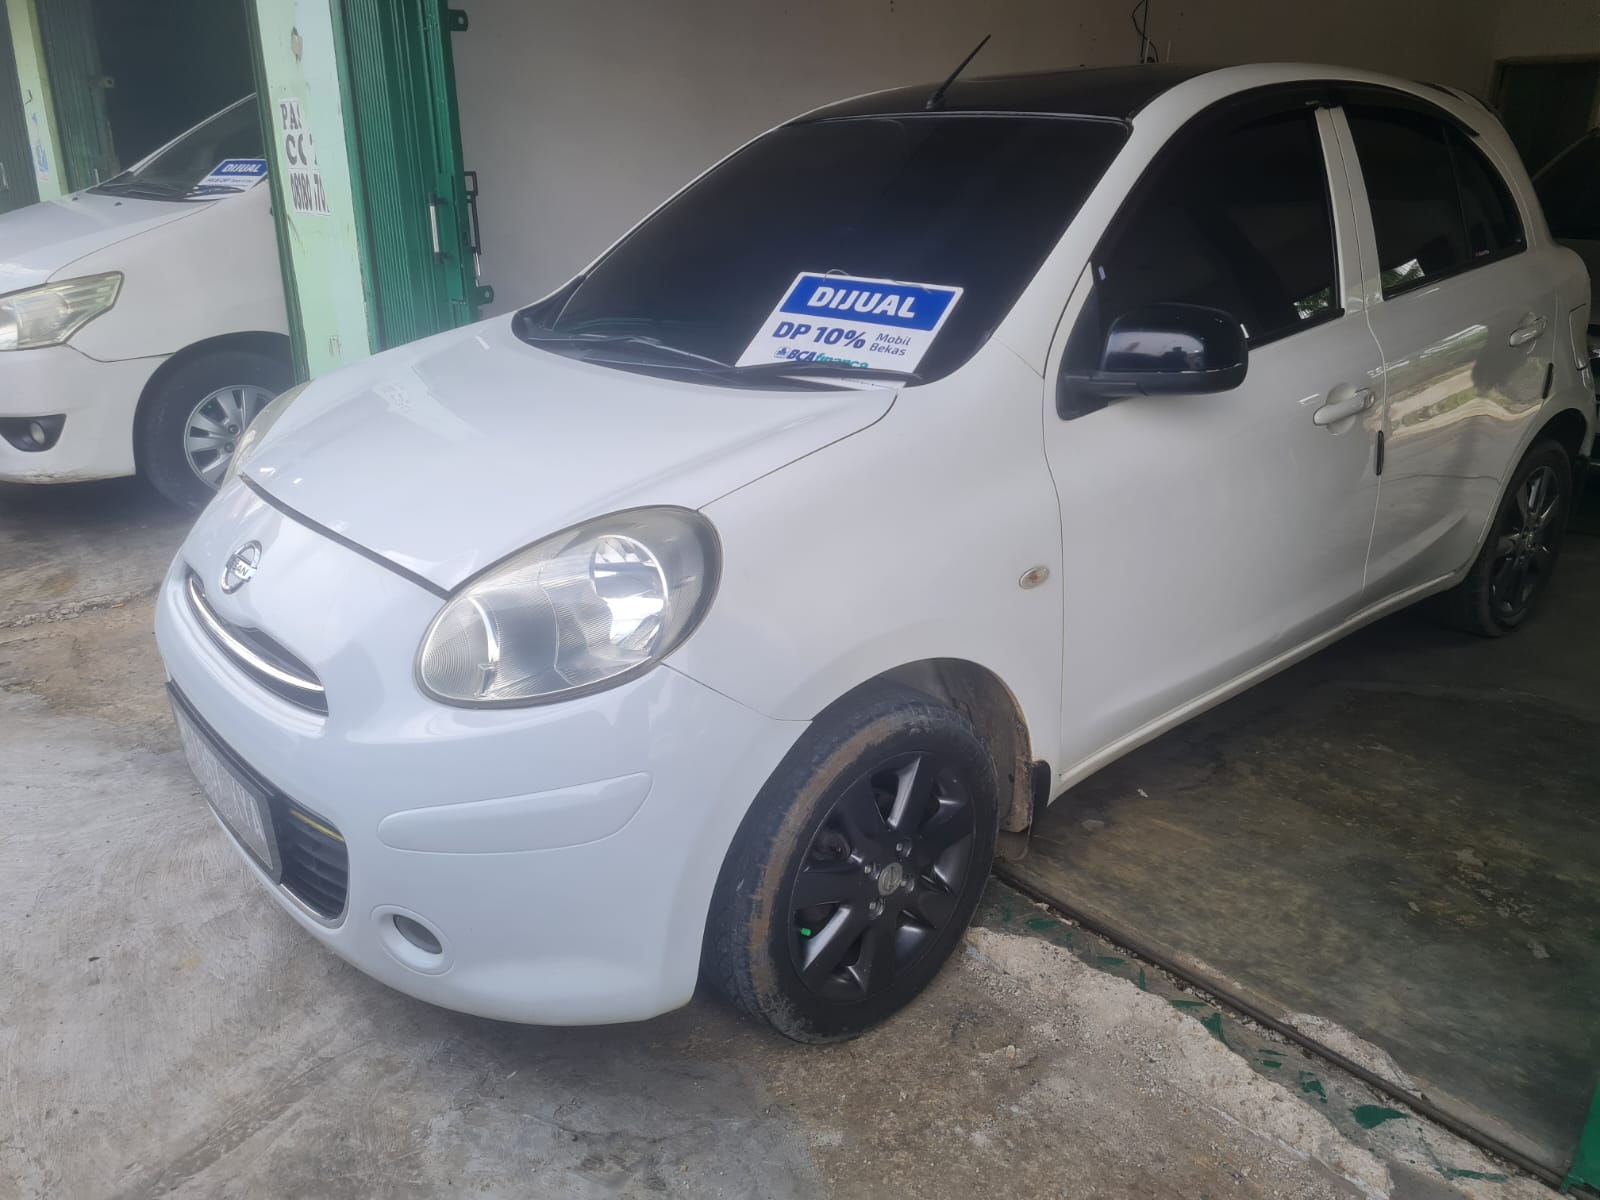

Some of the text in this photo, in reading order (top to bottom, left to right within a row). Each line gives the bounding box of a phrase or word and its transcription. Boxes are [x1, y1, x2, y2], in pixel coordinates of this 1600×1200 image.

[222, 163, 262, 173] DIJUAL
[807, 286, 915, 318] DIJUAL
[772, 321, 866, 349] DP 10%
[875, 333, 911, 346] Mobil
[786, 348, 817, 362] BCA
[869, 343, 907, 356] Bekas
